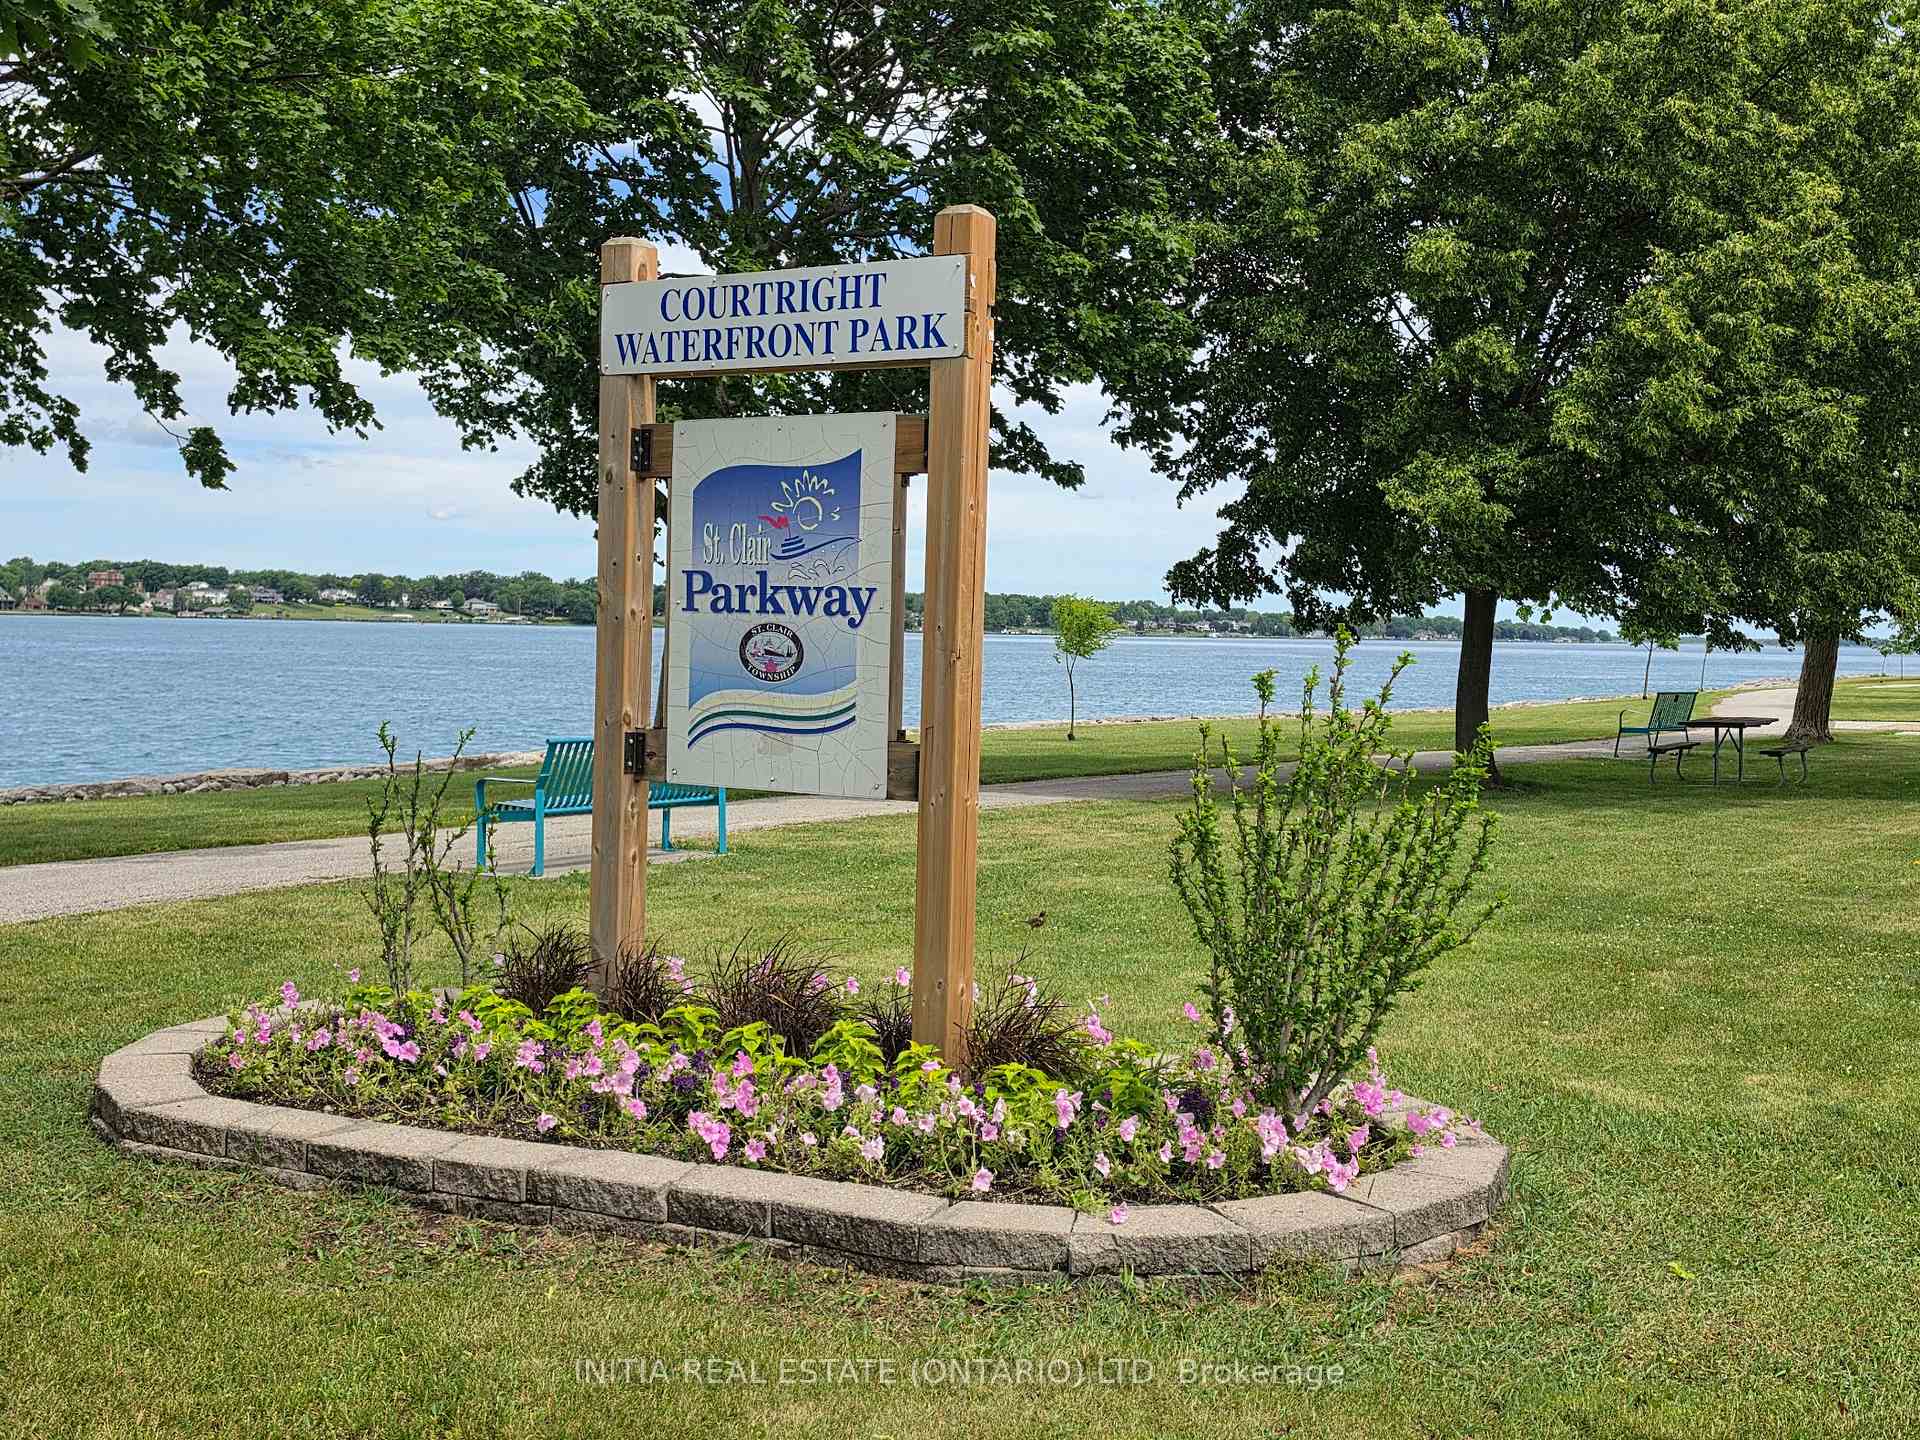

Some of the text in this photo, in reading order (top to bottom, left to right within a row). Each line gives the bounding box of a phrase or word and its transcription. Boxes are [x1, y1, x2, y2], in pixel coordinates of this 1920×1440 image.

[660, 273, 887, 322] COURTRIGHT
[615, 313, 948, 365] WATERFRONT PARK
[703, 523, 772, 566] St. Clair
[681, 570, 877, 629] Parkway
[751, 623, 794, 639] ST. CLAIR
[747, 664, 796, 681] TOWNSHIP
